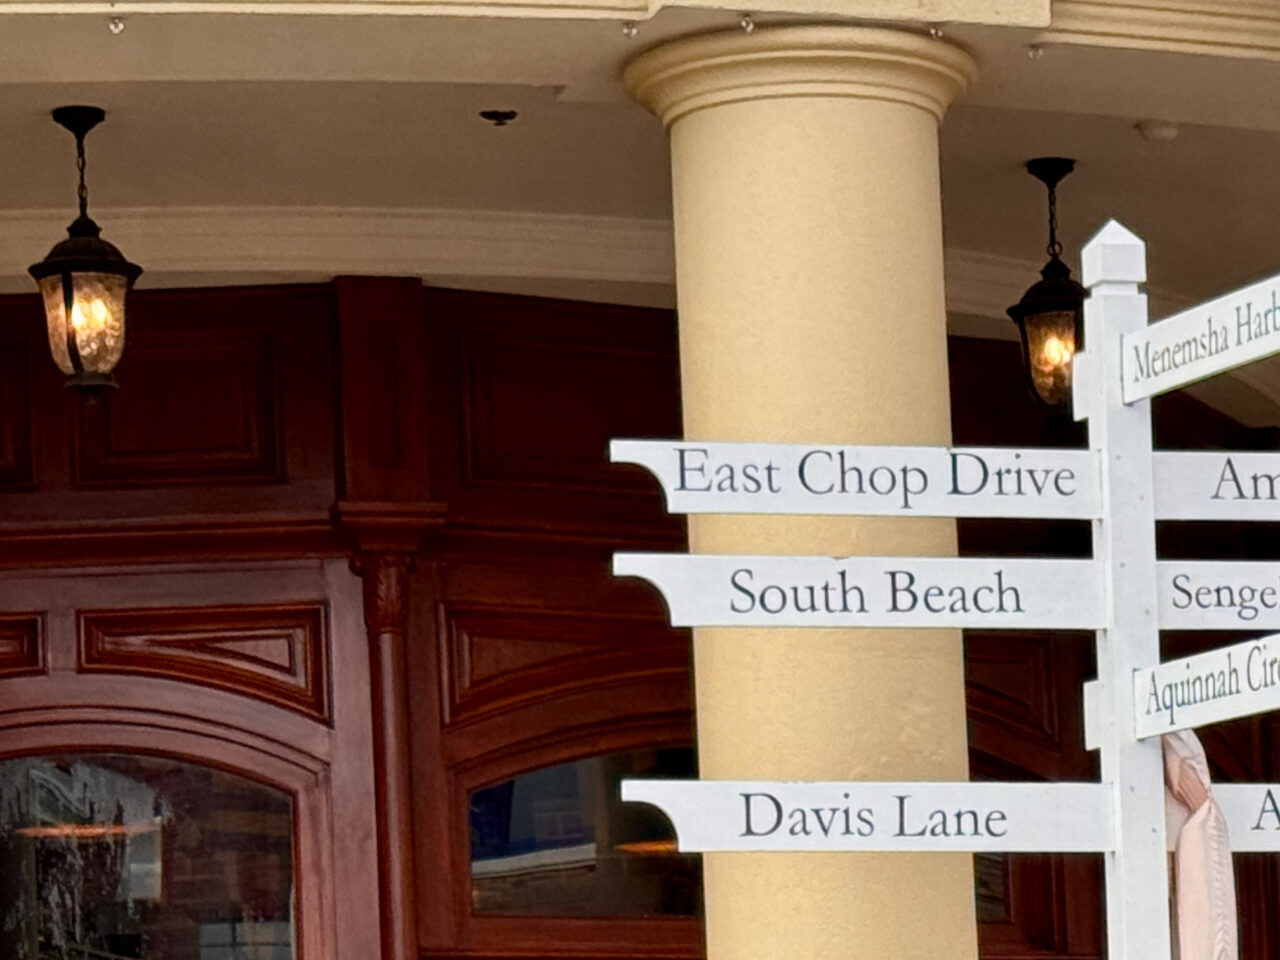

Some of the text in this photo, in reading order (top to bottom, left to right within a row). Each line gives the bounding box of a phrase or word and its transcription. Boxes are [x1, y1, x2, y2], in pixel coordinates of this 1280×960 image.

[1133, 315, 1230, 383] Menemsha
[673, 447, 1077, 509] East Chop Drive
[729, 568, 1026, 614] South Beach
[1145, 651, 1241, 726] Aquinnah
[738, 792, 1008, 838] Davis Lane
